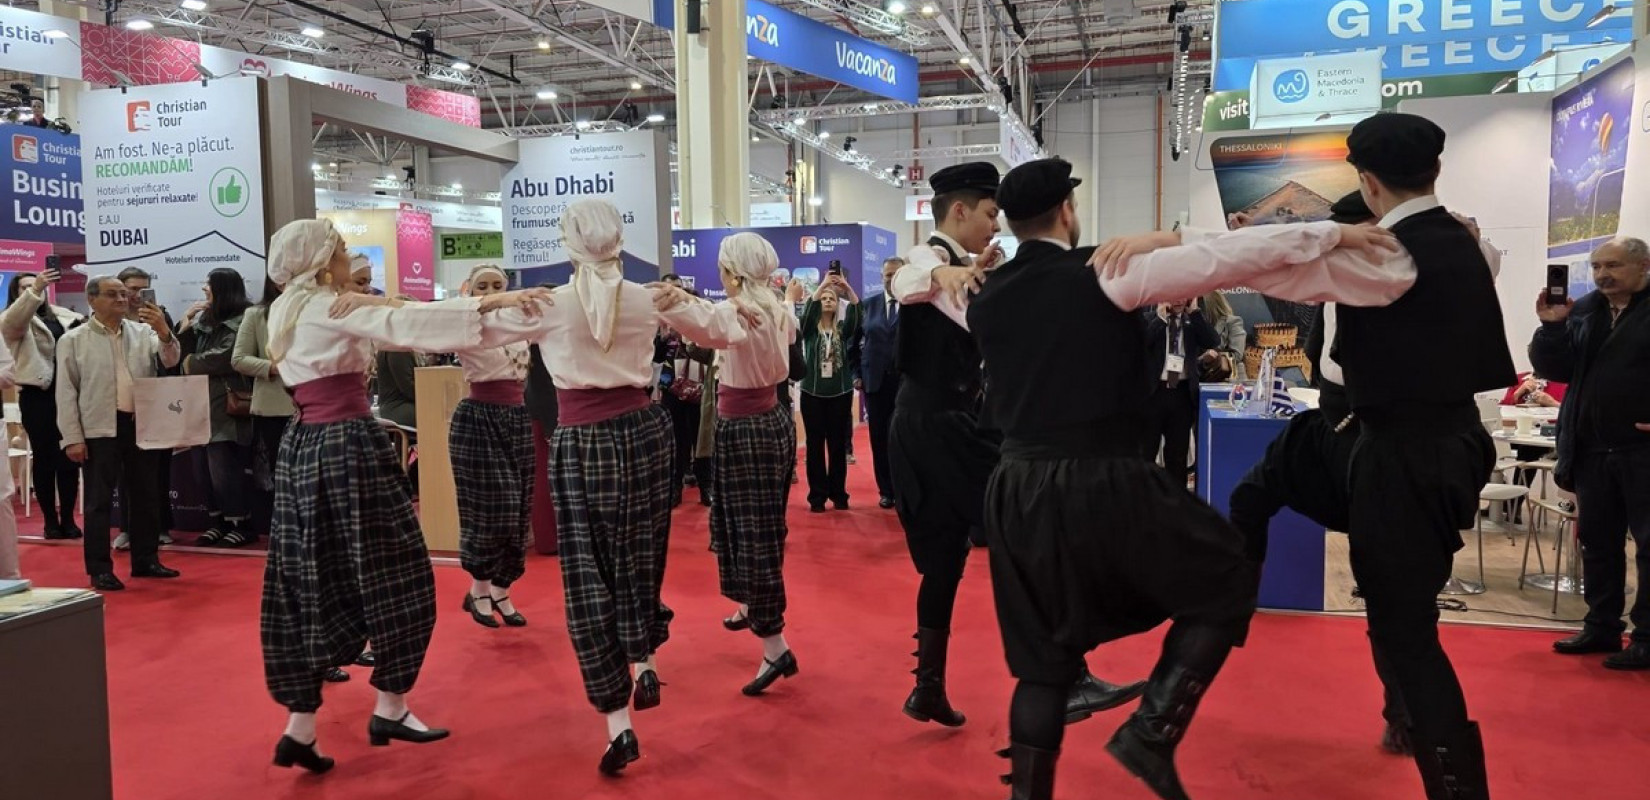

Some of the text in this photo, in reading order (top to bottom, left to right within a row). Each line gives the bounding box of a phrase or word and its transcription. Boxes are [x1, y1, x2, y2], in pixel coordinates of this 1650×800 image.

[1317, 69, 1353, 78] Eastern
[1317, 77, 1365, 88] Macedonia
[1328, 88, 1359, 97] Thrace
[156, 99, 207, 115] Christian
[1220, 98, 1250, 121] visit
[157, 116, 182, 128] Tour
[95, 136, 235, 160] Am fost. Ne-a plăcut.
[1220, 142, 1283, 153] THESSALONIKI
[43, 153, 67, 165] Tour
[96, 156, 194, 178] RECOMANDĂM!
[912, 169, 921, 180] H
[13, 169, 83, 199] Busin
[97, 183, 170, 196] Hoteluri verificate
[511, 171, 614, 198] Abu Dhabi
[97, 197, 124, 208] pentru
[127, 194, 159, 207] sejururi
[622, 211, 635, 225] tă
[100, 228, 148, 247] DUBAI
[818, 237, 849, 245] Christian
[165, 253, 241, 265] Hoteluri recomandate
[513, 251, 549, 263] ritmul!
